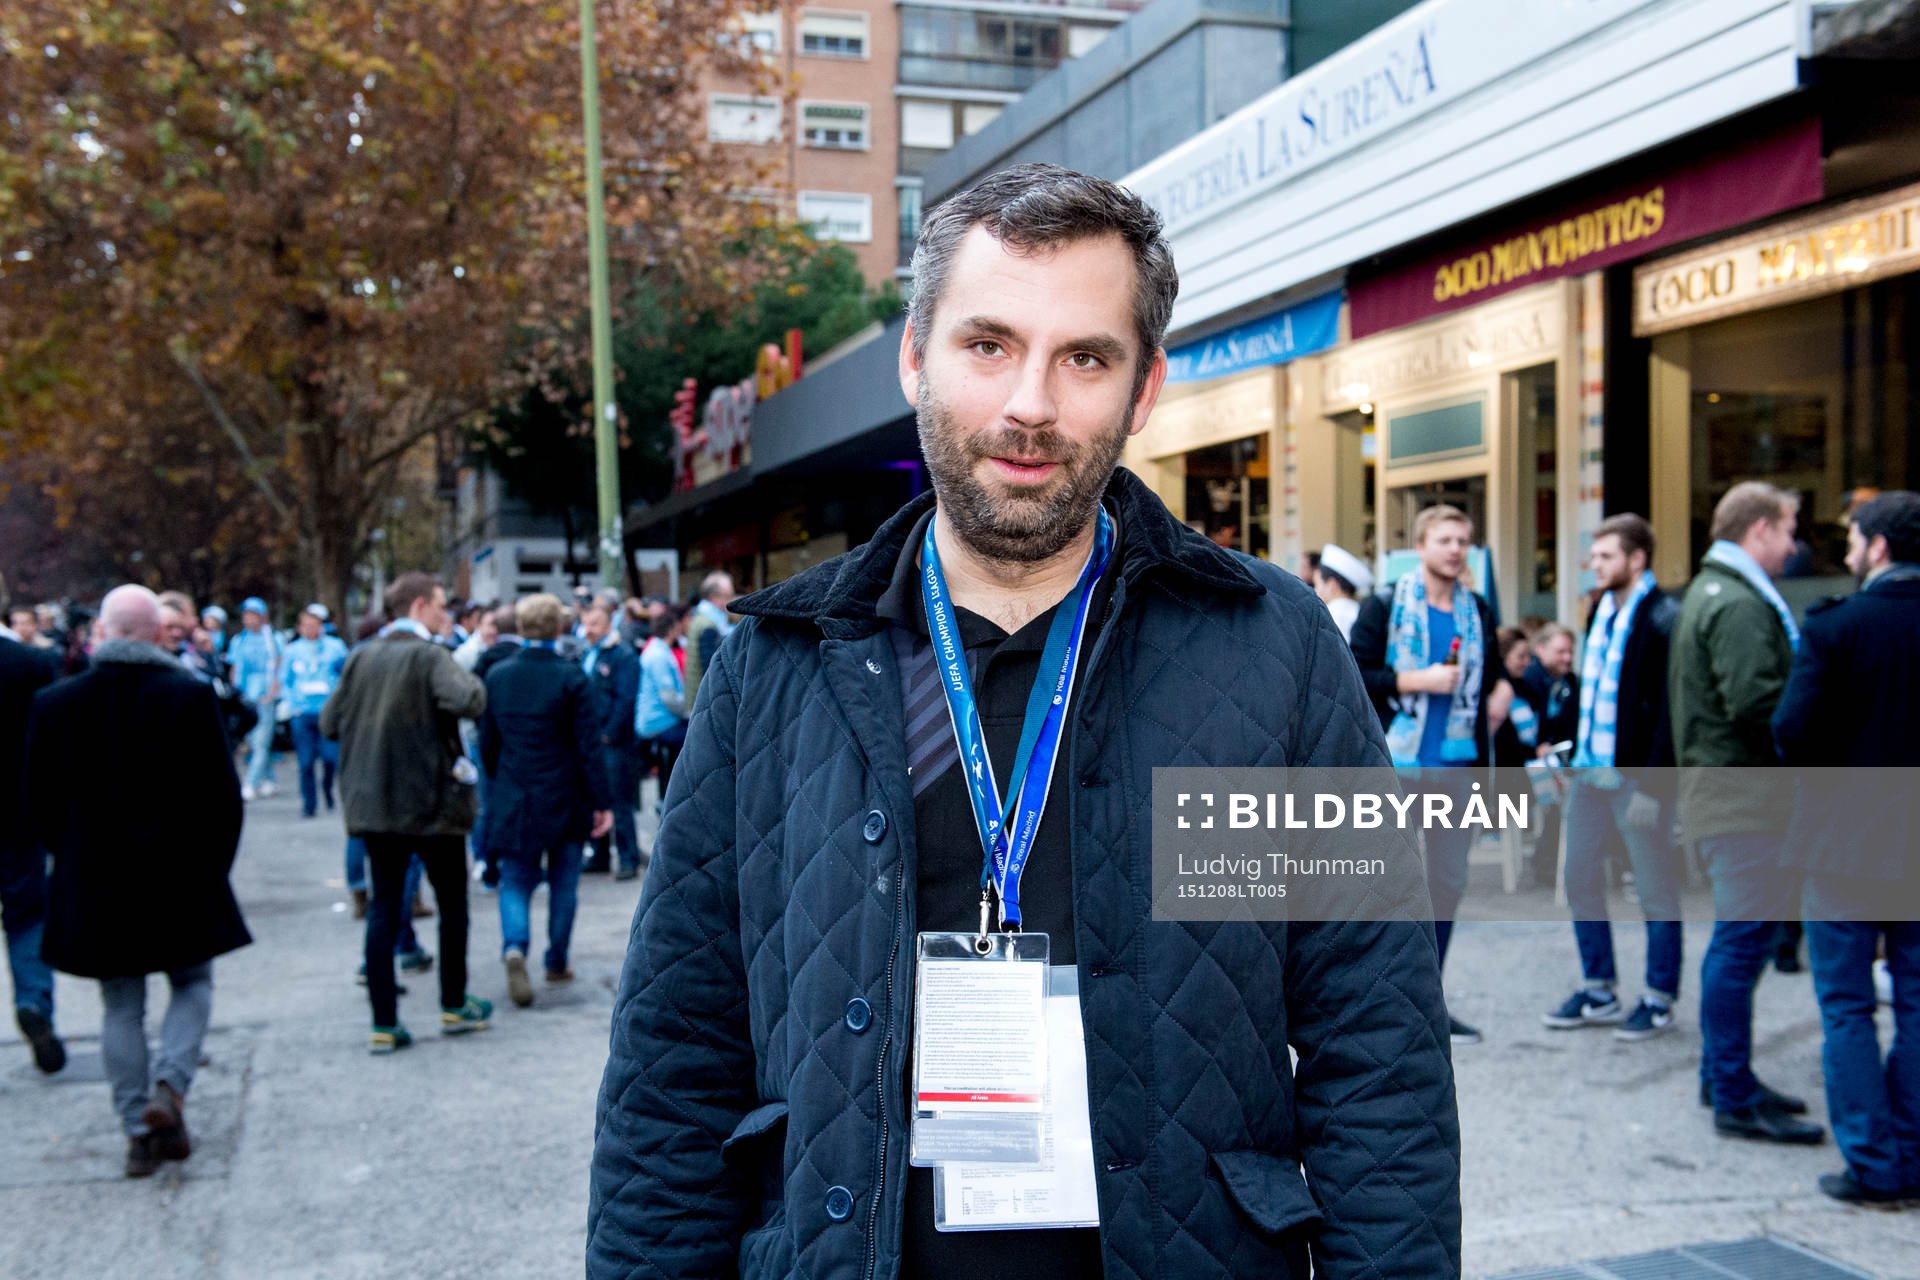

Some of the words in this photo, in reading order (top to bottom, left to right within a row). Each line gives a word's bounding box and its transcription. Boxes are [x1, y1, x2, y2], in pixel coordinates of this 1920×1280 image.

[926, 563, 940, 600] LEAGUE
[934, 601, 956, 661] CHAMPIONS
[948, 662, 964, 691] UEFA
[1016, 840, 1027, 861] Real
[1022, 810, 1036, 840] Madrid
